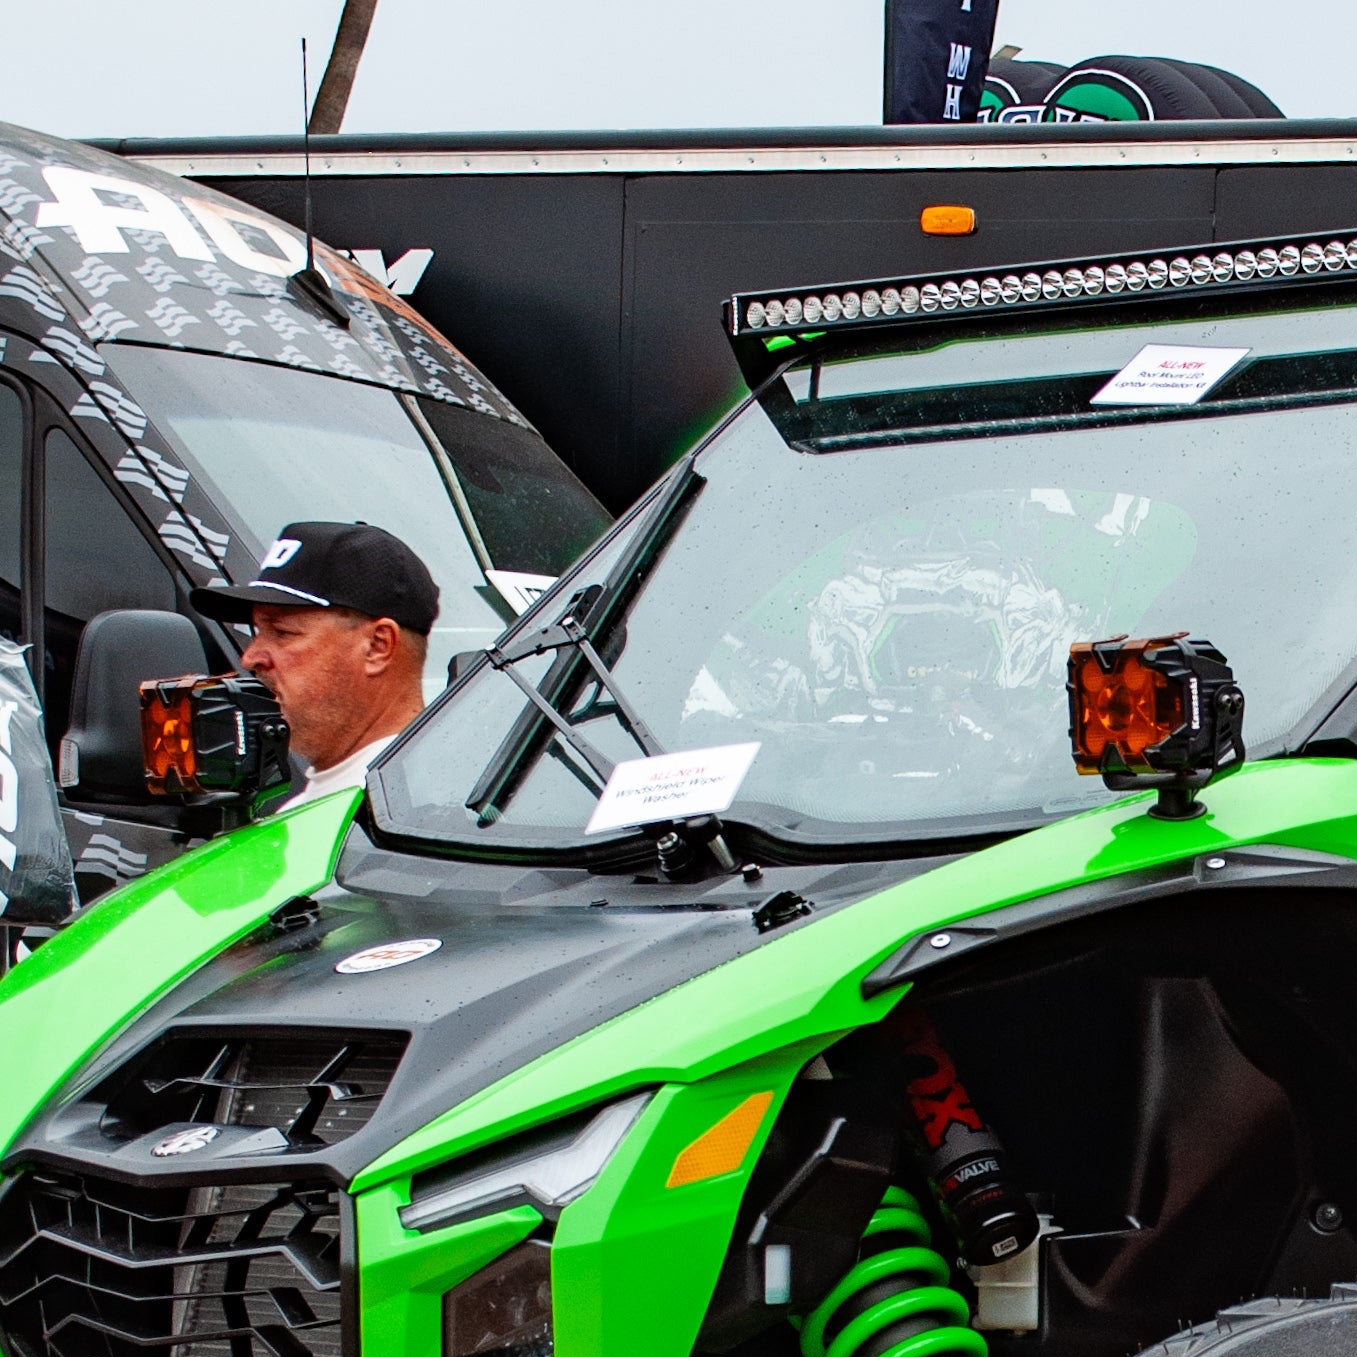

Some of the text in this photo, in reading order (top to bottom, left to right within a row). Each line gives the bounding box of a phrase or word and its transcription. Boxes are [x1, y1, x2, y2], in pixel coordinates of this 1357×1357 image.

[1159, 360, 1206, 370] ALL-NEW
[1189, 677, 1201, 730] Kawasaki
[649, 767, 707, 781] ALL-NEW
[615, 775, 727, 799] Windshield Wiper
[642, 790, 691, 805] Washer
